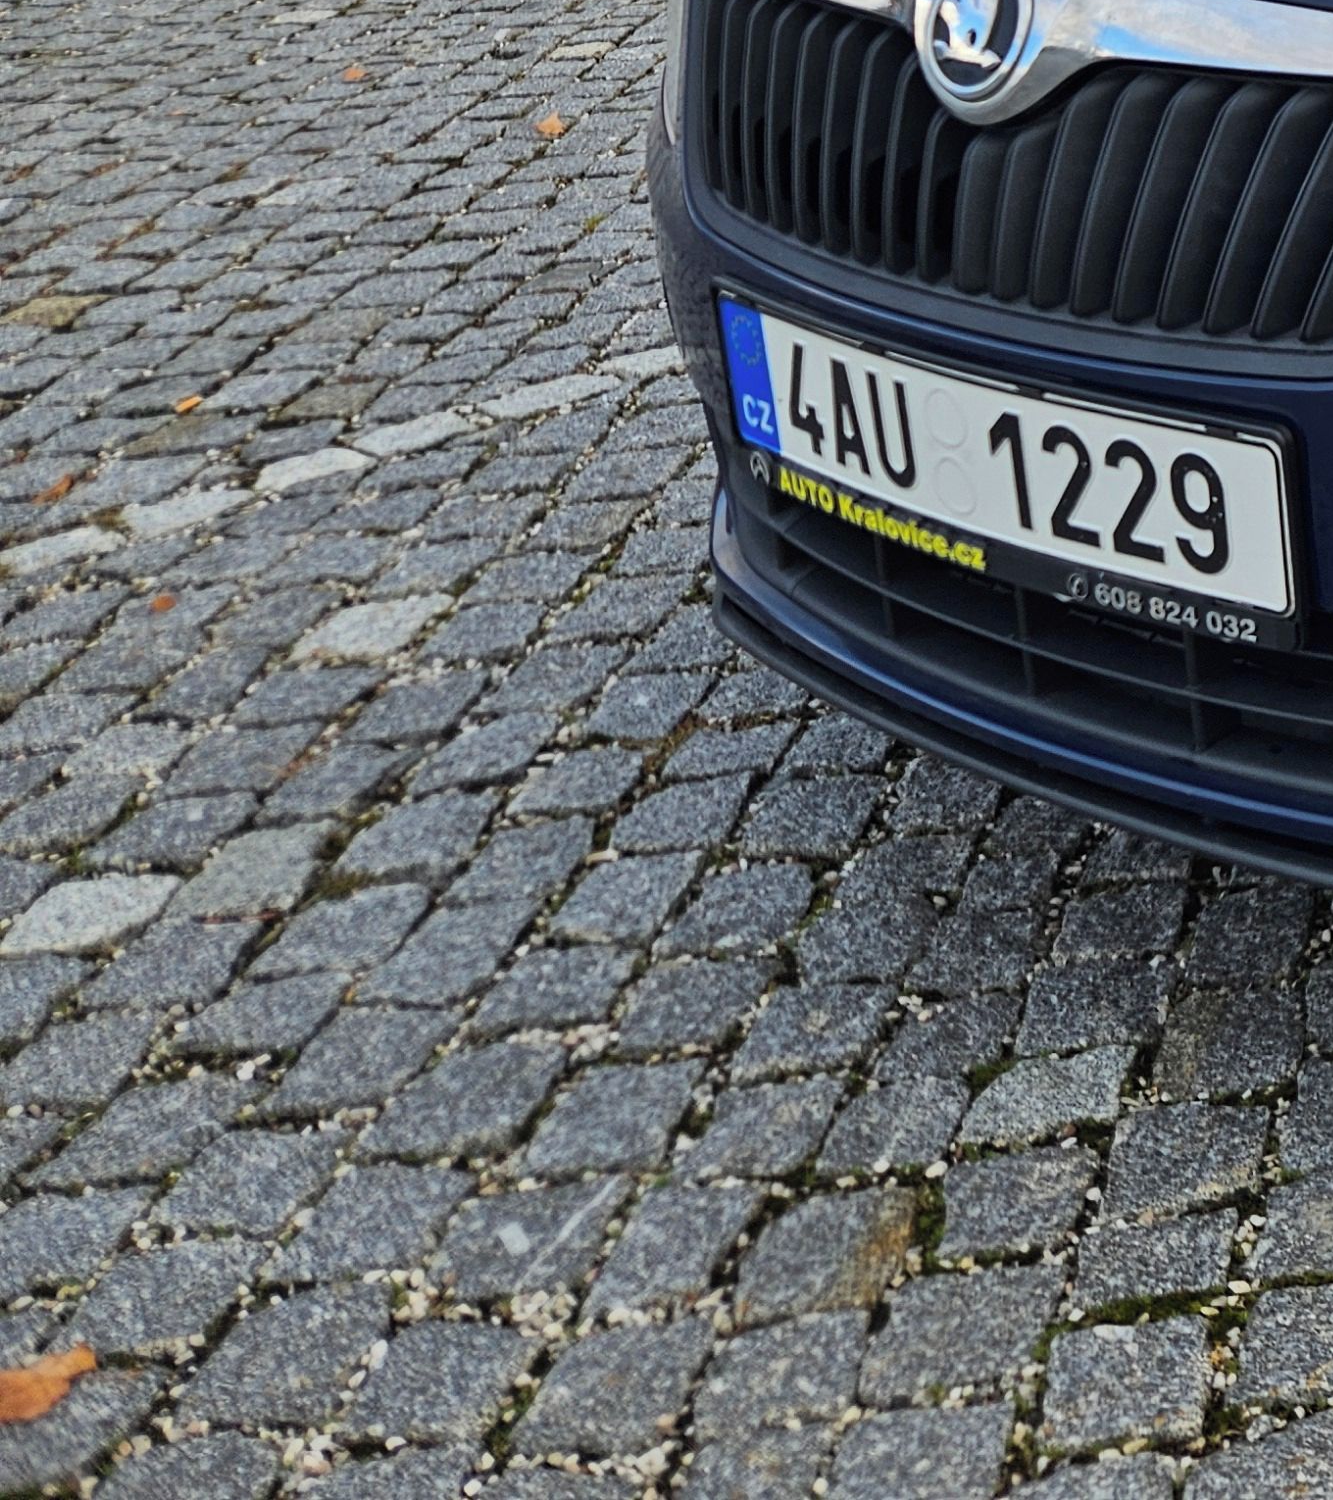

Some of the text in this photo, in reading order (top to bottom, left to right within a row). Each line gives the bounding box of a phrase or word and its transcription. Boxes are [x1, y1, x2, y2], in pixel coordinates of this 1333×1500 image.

[742, 393, 775, 436] CZ
[790, 341, 1229, 575] 4AU 1229
[778, 466, 987, 573] AUTO Kralovice.cz
[1094, 582, 1258, 644] 608 824 032
